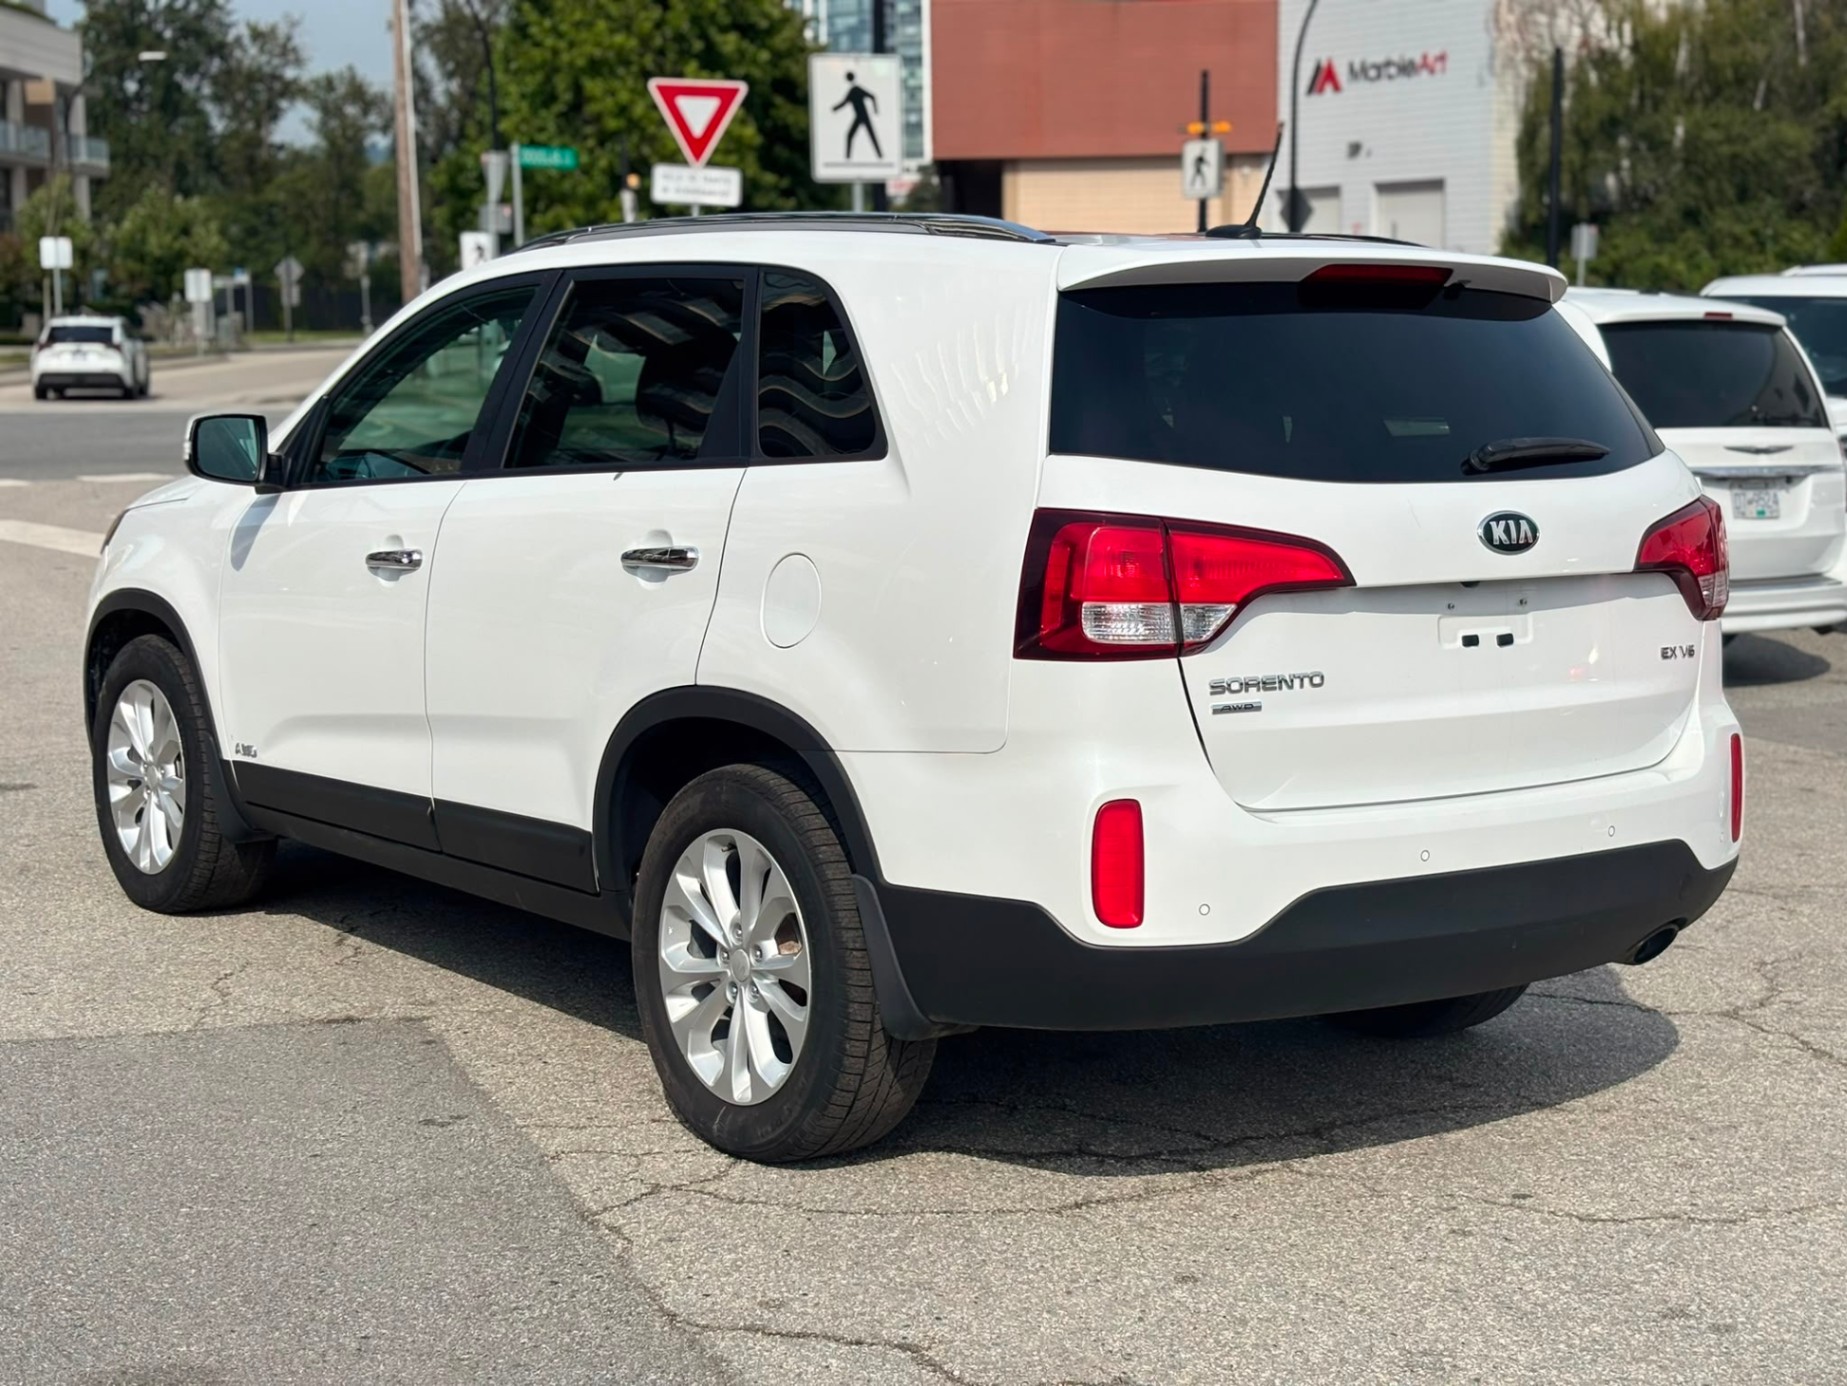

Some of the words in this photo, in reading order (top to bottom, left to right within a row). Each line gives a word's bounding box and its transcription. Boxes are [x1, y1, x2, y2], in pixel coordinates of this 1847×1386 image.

[1489, 519, 1533, 545] KIA
[1660, 646, 1677, 660] EX
[1679, 644, 1695, 659] V6
[1208, 671, 1325, 696] SORENTO
[1220, 703, 1254, 712] AWD
